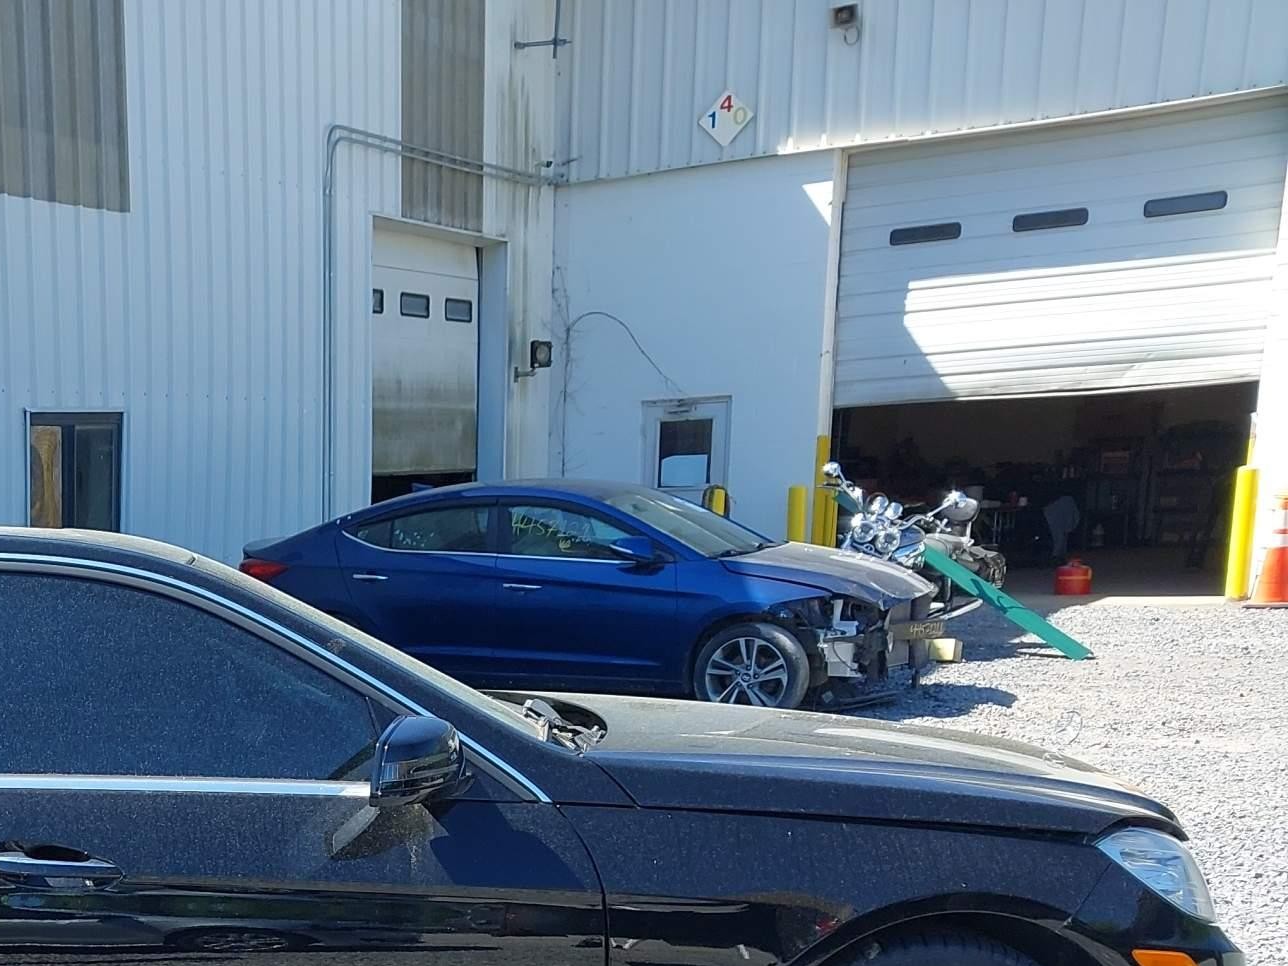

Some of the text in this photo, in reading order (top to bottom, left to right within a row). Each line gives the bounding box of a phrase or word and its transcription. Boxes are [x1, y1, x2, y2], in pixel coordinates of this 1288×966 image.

[720, 95, 734, 112] 4
[708, 111, 716, 129] 1
[734, 107, 748, 125] 0
